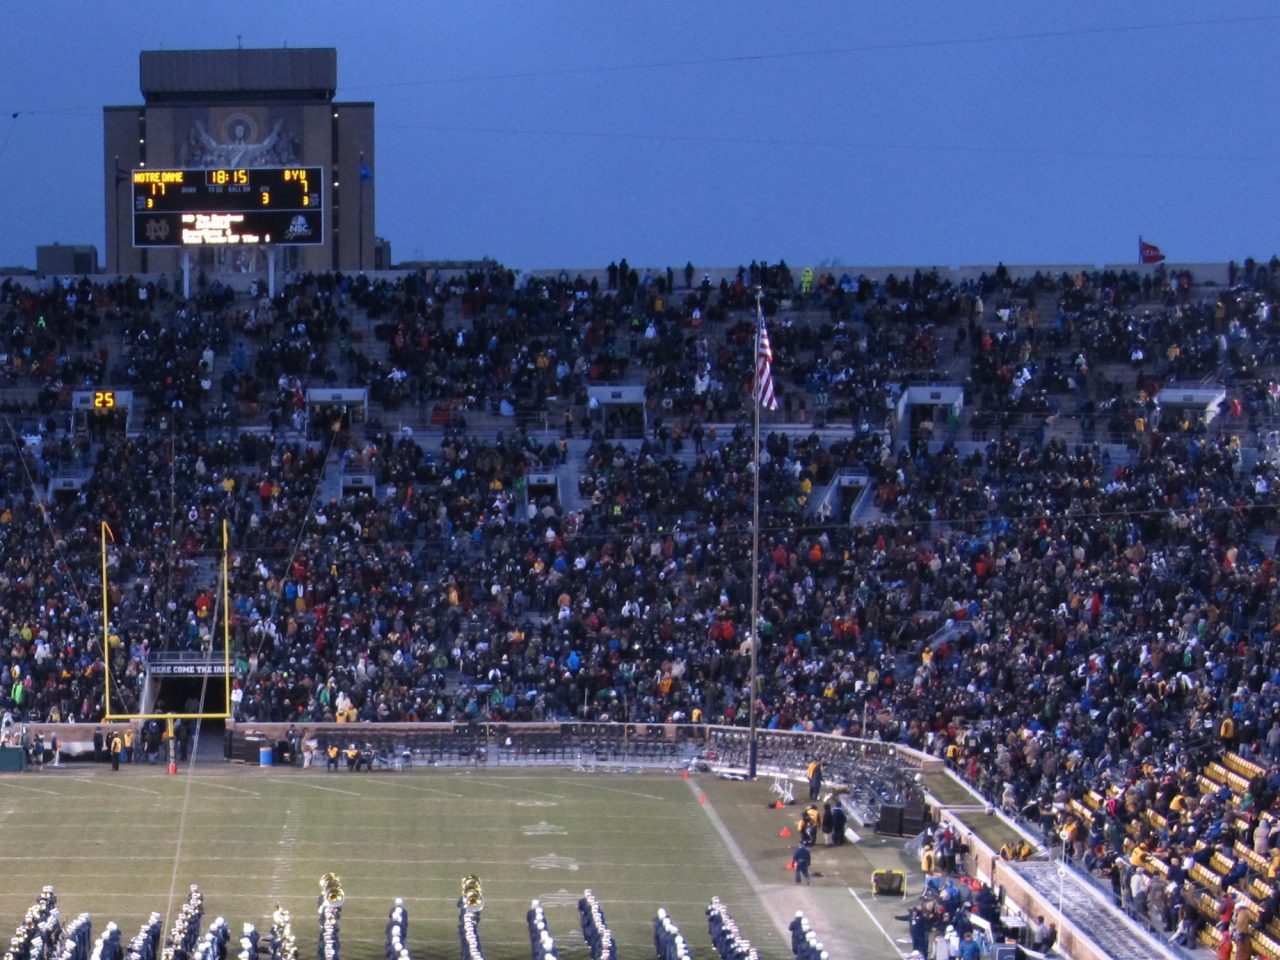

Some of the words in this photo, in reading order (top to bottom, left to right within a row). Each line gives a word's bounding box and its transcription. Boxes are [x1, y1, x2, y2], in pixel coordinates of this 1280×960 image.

[134, 171, 161, 182] NOTRE
[161, 171, 183, 182] DAME
[212, 170, 247, 184] 18:15
[284, 170, 307, 180] BYU
[152, 183, 165, 195] 17
[301, 181, 308, 193] 7
[147, 198, 153, 208] 3
[262, 192, 269, 204] 3
[303, 196, 309, 206] 3
[289, 224, 308, 232] NBC
[95, 392, 114, 408] 25
